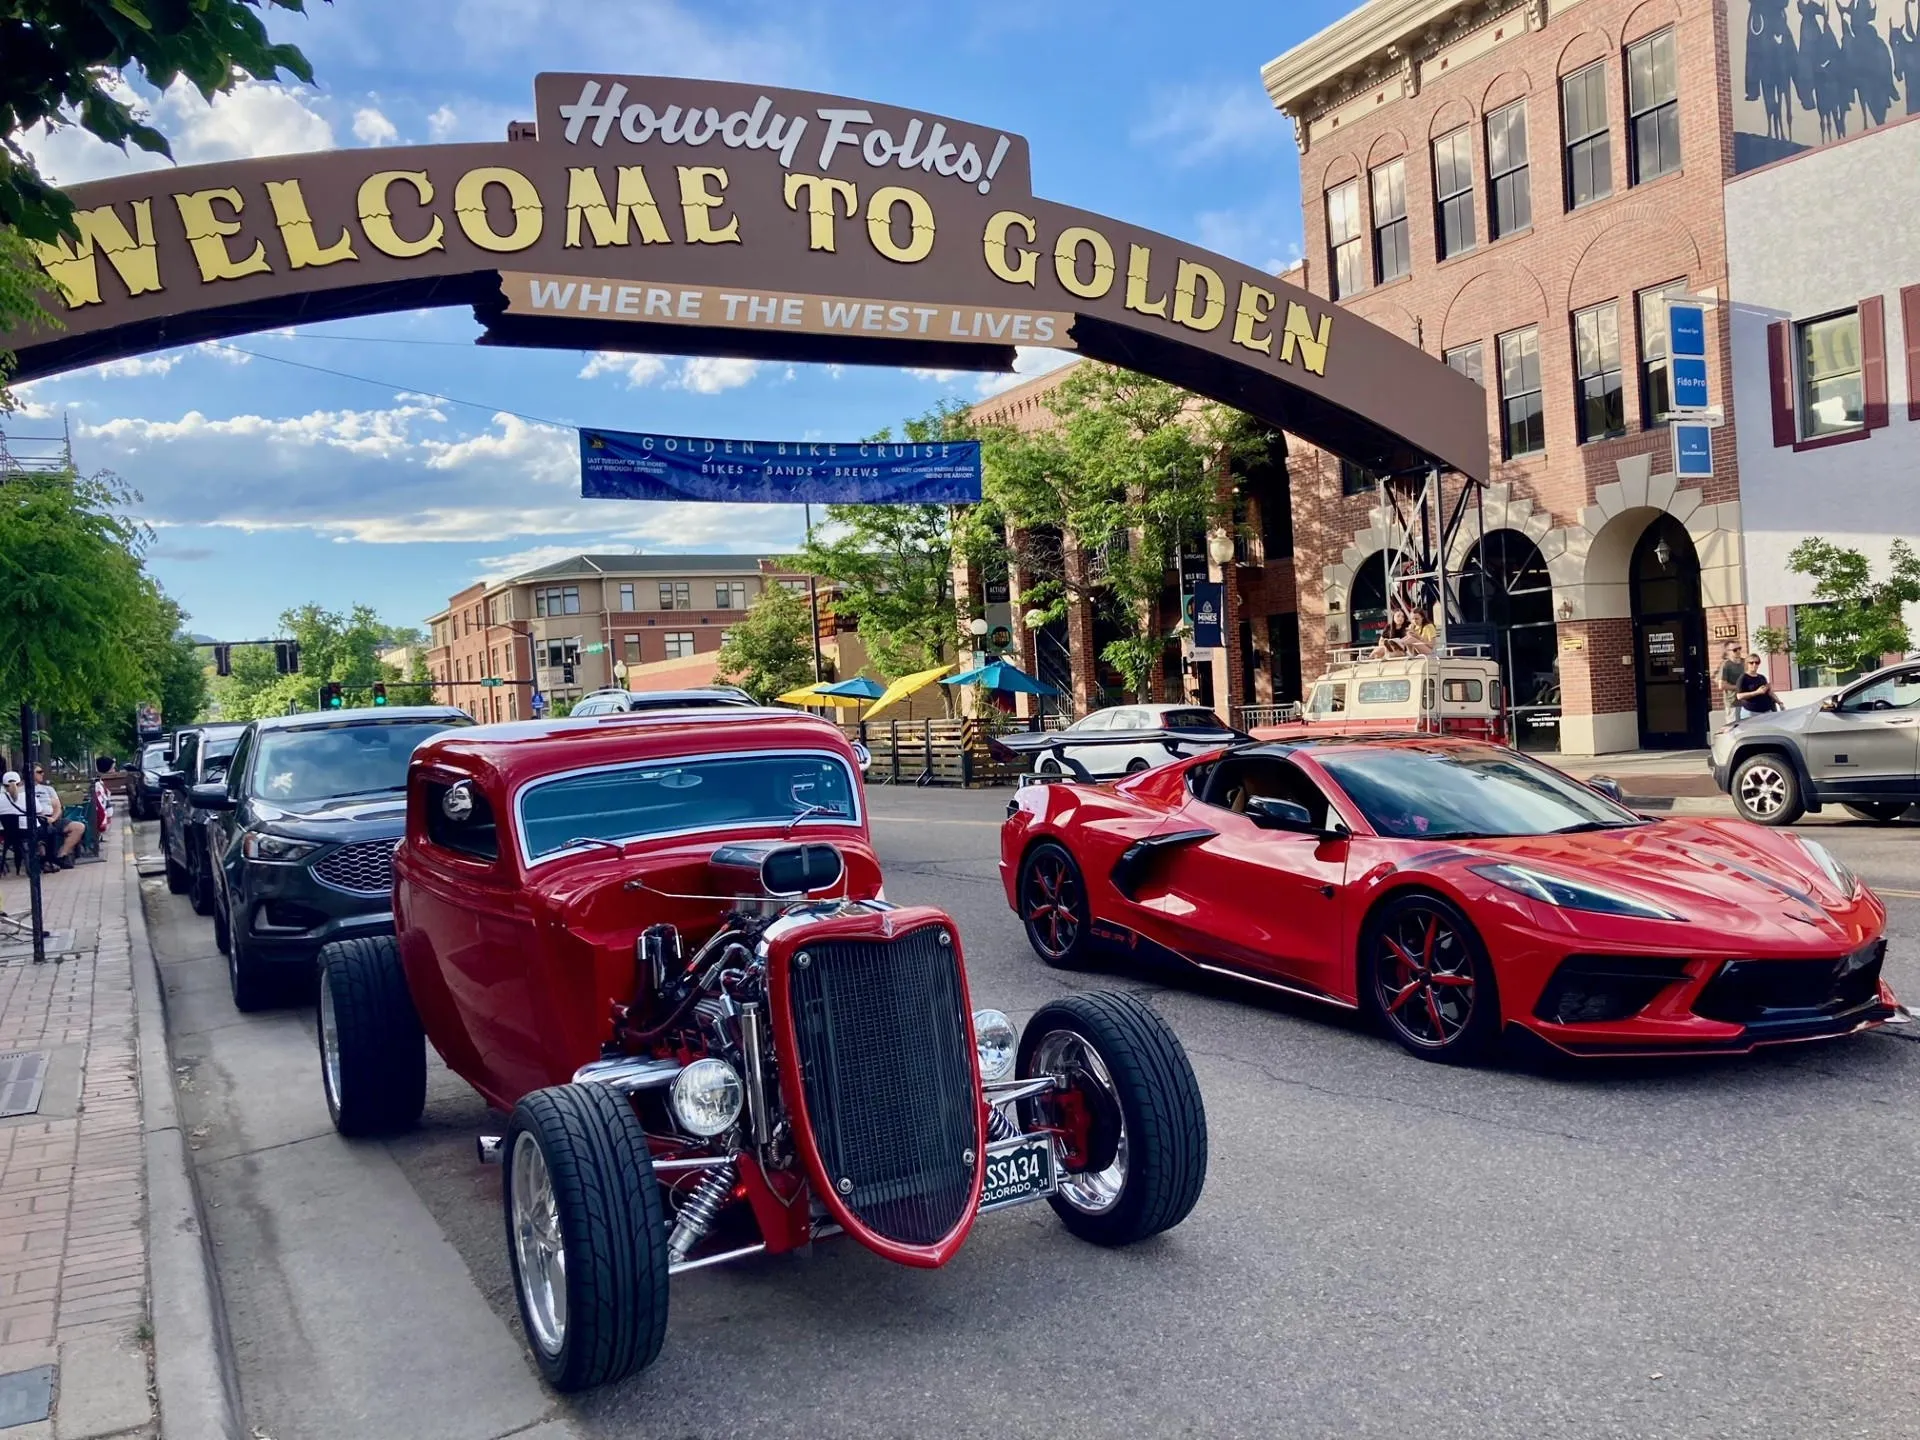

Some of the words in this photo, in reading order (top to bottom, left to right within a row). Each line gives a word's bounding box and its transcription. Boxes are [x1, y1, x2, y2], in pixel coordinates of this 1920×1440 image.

[559, 80, 807, 168] Howdy
[816, 108, 1011, 195] Folks!
[34, 165, 742, 309] WELCOME
[783, 172, 937, 264] TO
[982, 209, 1334, 377] GOLDEN
[529, 279, 703, 319] WHERE
[720, 293, 804, 325] THE
[821, 301, 939, 334] WEST
[949, 310, 1056, 342] LIVES
[1676, 376, 1692, 387] Fido
[1693, 377, 1706, 387] Pro
[642, 436, 756, 455] GOLDEN
[778, 442, 838, 457] BIKE
[859, 444, 950, 458] CRUISE
[701, 463, 744, 475] BIKES
[766, 464, 814, 477] BANDS
[835, 466, 880, 478] BREWS
[1197, 614, 1217, 622] MINES
[983, 1153, 1040, 1191] SSA34
[979, 1181, 1032, 1203] COLORADO
